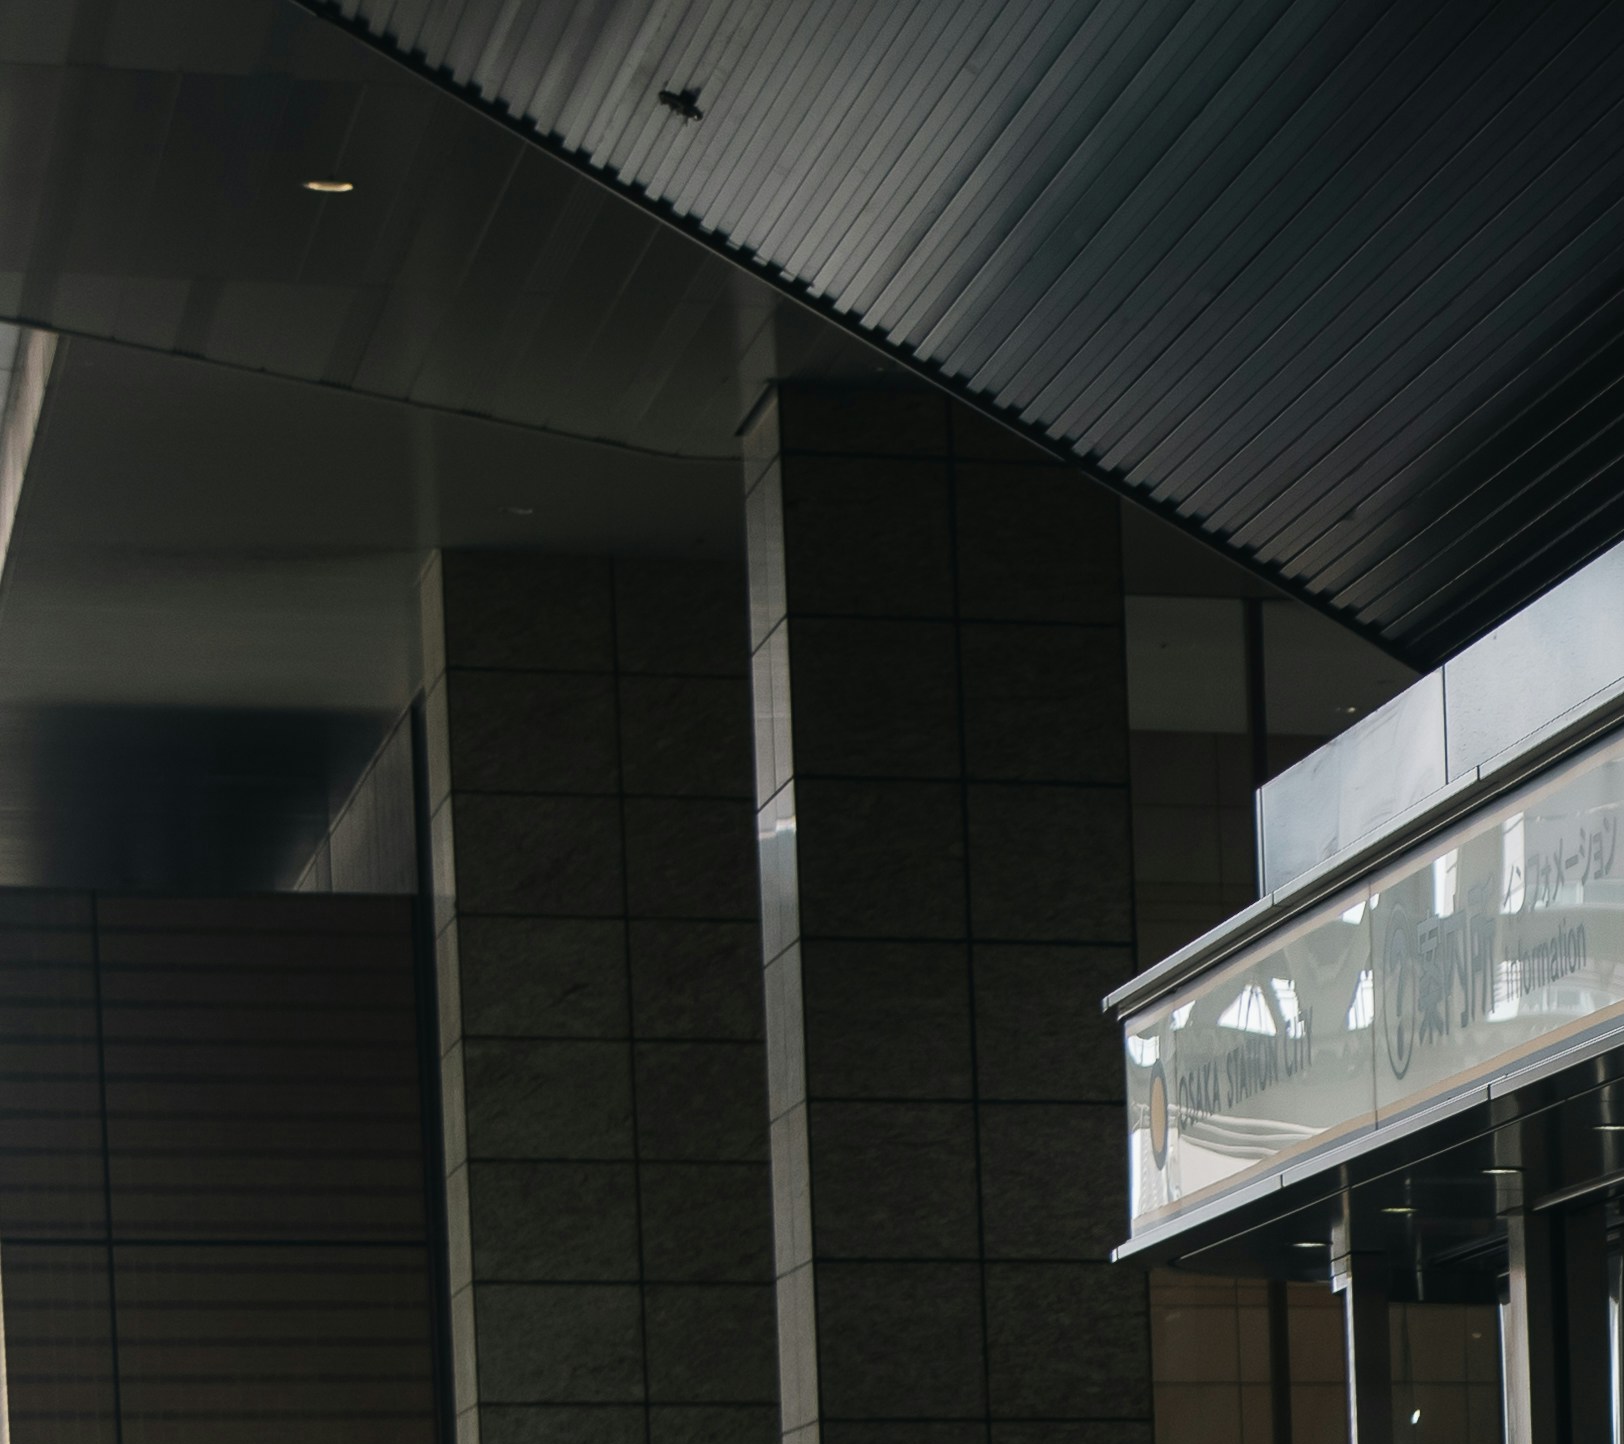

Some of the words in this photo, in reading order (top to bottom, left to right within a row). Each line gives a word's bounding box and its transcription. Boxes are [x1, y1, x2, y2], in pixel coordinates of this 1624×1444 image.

[1507, 919, 1587, 1003] Information
[1179, 1062, 1221, 1130] OSAKA
[1227, 1036, 1279, 1109] STATION
[1285, 1006, 1313, 1077] CITY
